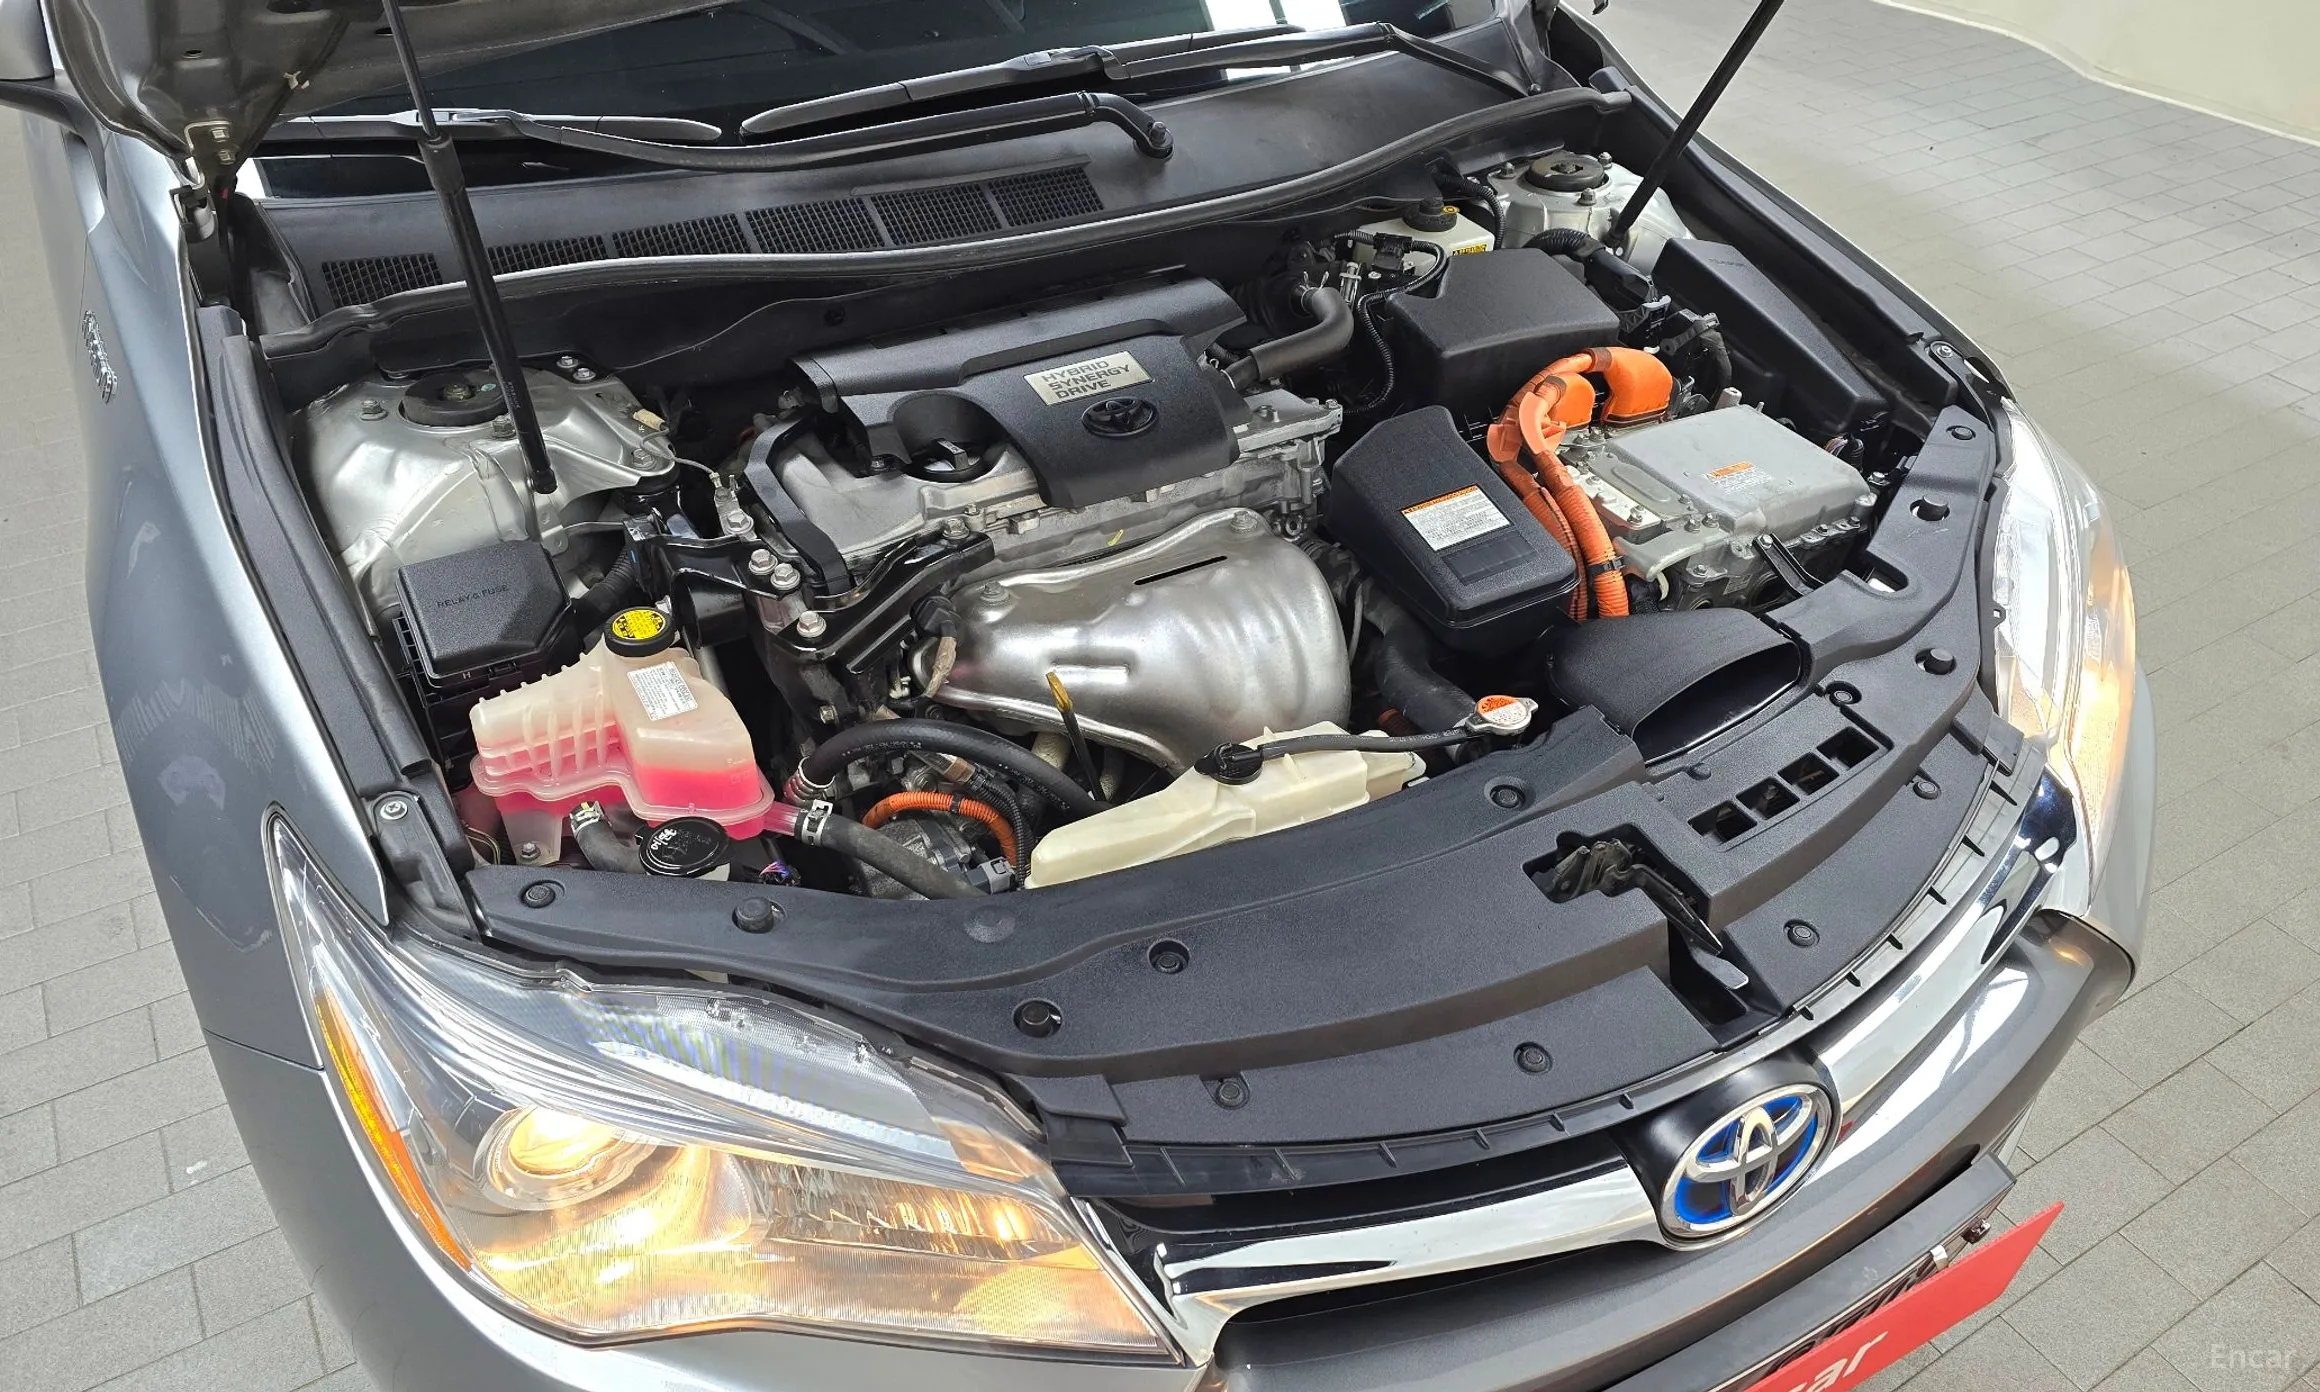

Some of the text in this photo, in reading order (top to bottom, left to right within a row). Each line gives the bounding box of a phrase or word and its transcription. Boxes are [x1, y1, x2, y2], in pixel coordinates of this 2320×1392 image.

[1042, 361, 1109, 382] HYBRID
[1048, 365, 1130, 391] SYNERGY
[1055, 379, 1112, 399] DRIVE
[436, 594, 470, 608] RELAY
[481, 584, 509, 597] FUSE
[1786, 1331, 1888, 1392] ar
